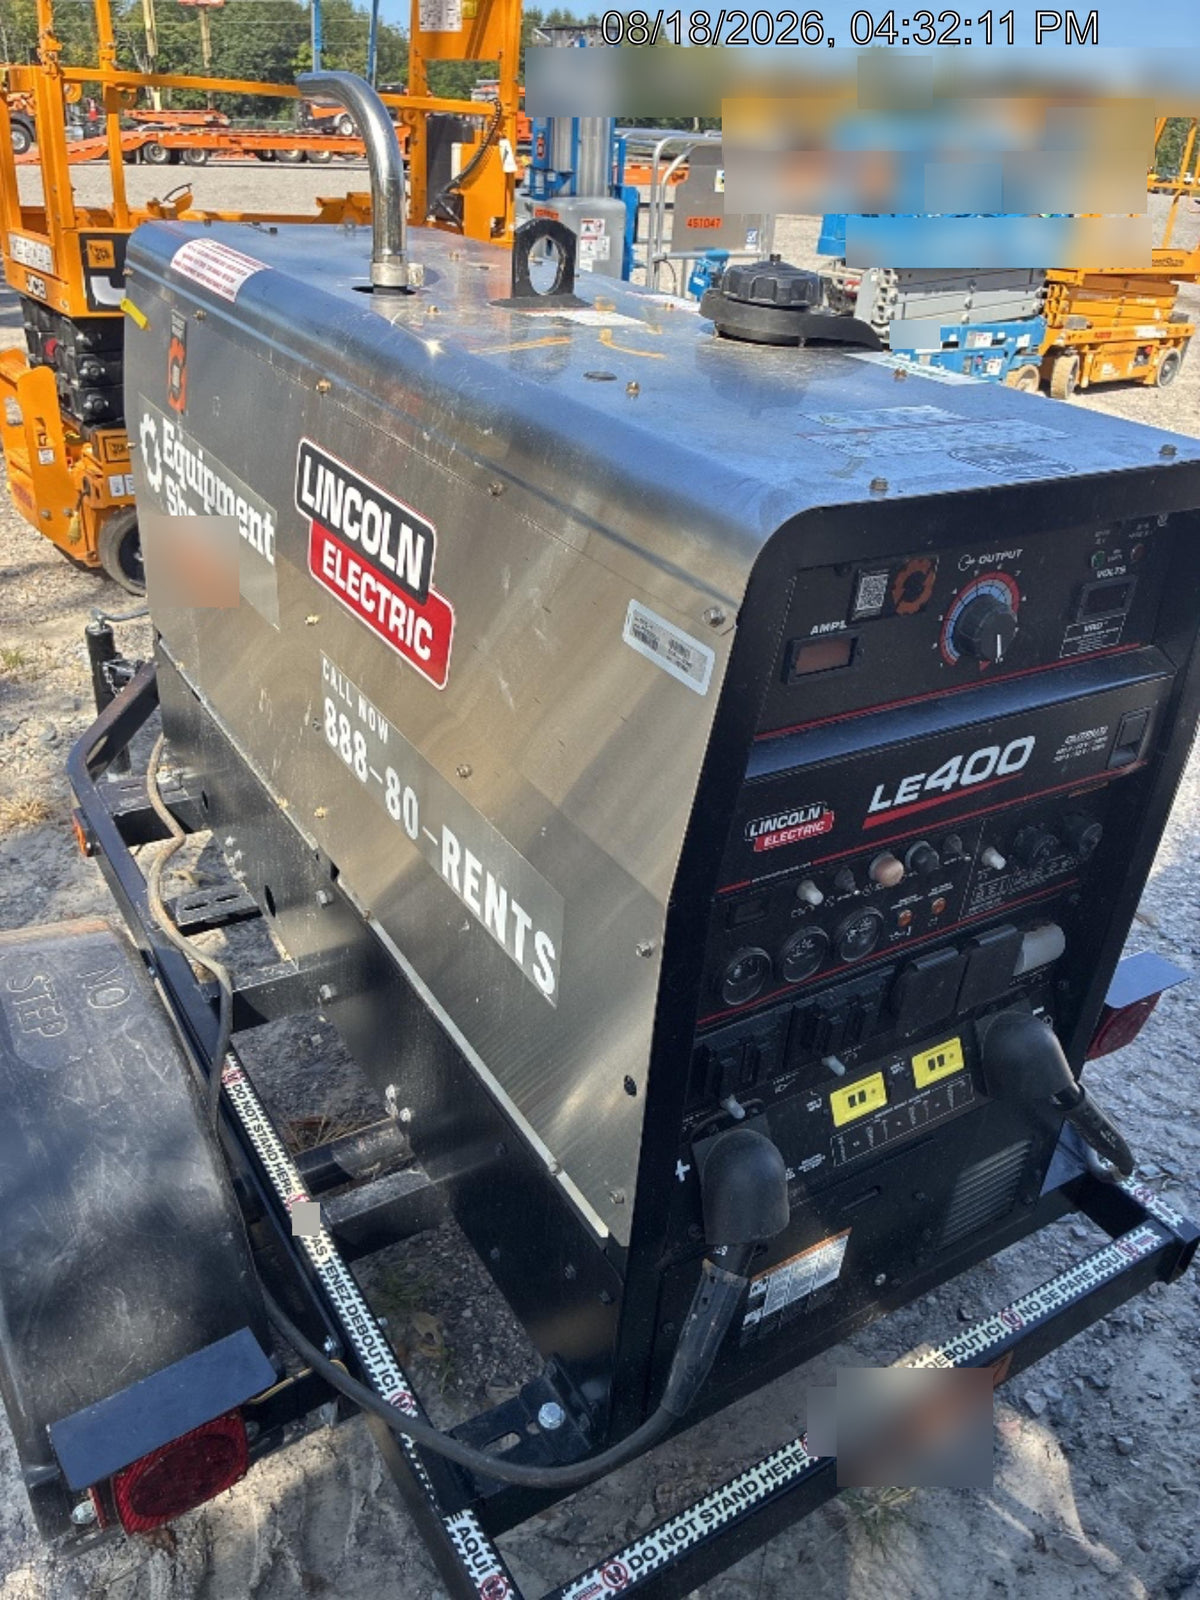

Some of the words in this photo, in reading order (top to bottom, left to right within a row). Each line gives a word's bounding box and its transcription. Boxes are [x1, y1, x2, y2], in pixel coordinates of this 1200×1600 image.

[687, 218, 721, 228] 451047
[162, 417, 276, 563] Equipment
[301, 454, 426, 589] LINCOLN
[978, 549, 1024, 565] OUTPUT
[322, 537, 434, 661] ELECTRIC
[322, 657, 353, 708] CALL
[358, 704, 390, 745] NOW
[869, 736, 1037, 815] LE400
[323, 697, 557, 995] 888-80-RENTS
[750, 805, 821, 837] LINCOLN
[764, 821, 826, 847] ELECTRIC
[6, 973, 69, 1038] STEP
[77, 963, 133, 1009] NO
[232, 1084, 247, 1099] DO
[241, 1099, 260, 1122] NOT
[253, 1123, 278, 1162] STAND
[323, 1257, 353, 1306] TENEZ
[346, 1303, 387, 1365] DEBOUT
[378, 1365, 399, 1393] ICI
[982, 1322, 1004, 1340] ICI
[1018, 1303, 1040, 1319] NO
[1040, 1290, 1060, 1310] SE
[1059, 1269, 1093, 1296] PARE
[627, 1545, 659, 1571] DO
[658, 1521, 698, 1552] NOT
[699, 1480, 760, 1526] STAND
[757, 1447, 808, 1487] HERE
